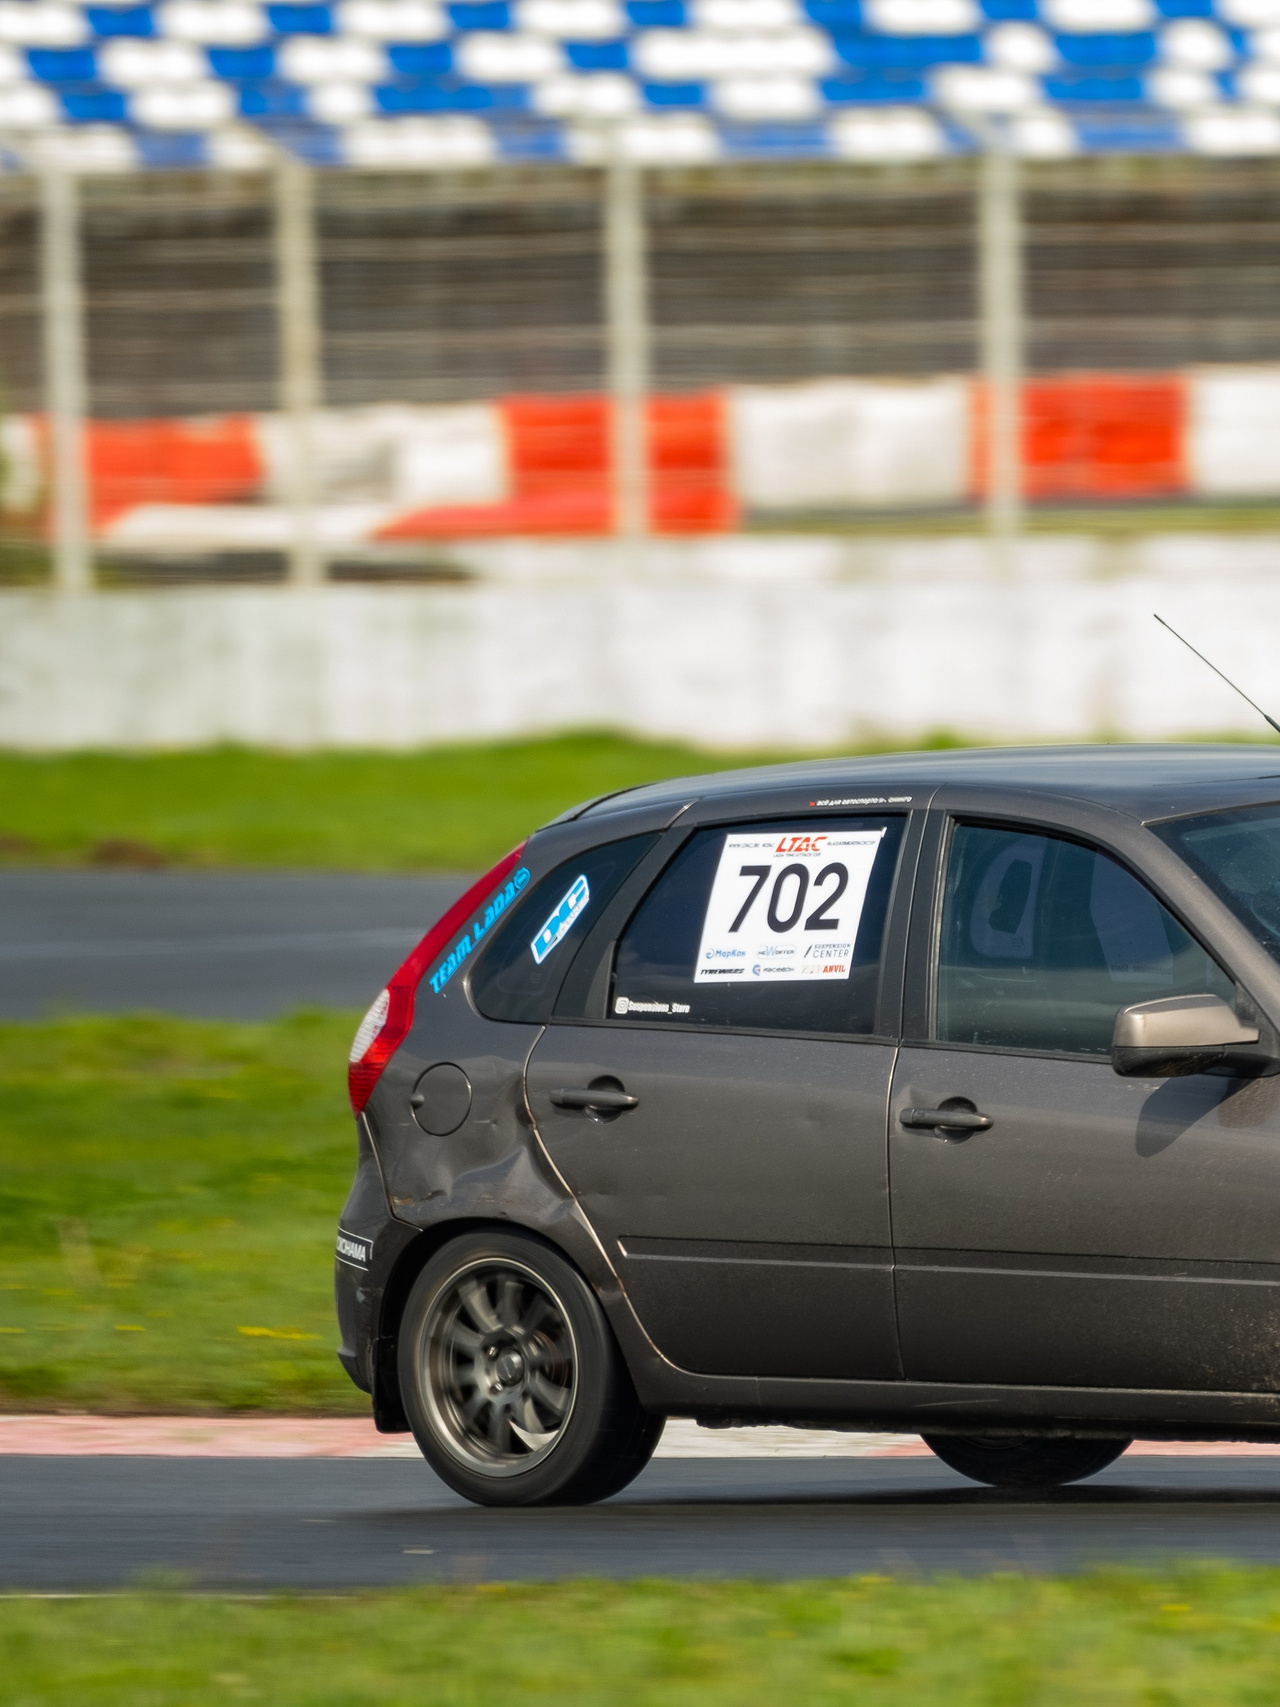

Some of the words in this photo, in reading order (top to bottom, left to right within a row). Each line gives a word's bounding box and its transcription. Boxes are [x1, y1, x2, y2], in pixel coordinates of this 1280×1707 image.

[775, 836, 829, 853] LTAC
[728, 862, 849, 933] 702
[429, 934, 473, 994] TEAM
[473, 881, 517, 942] LADA
[812, 950, 850, 958] CENTER
[822, 964, 847, 973] ANVIL
